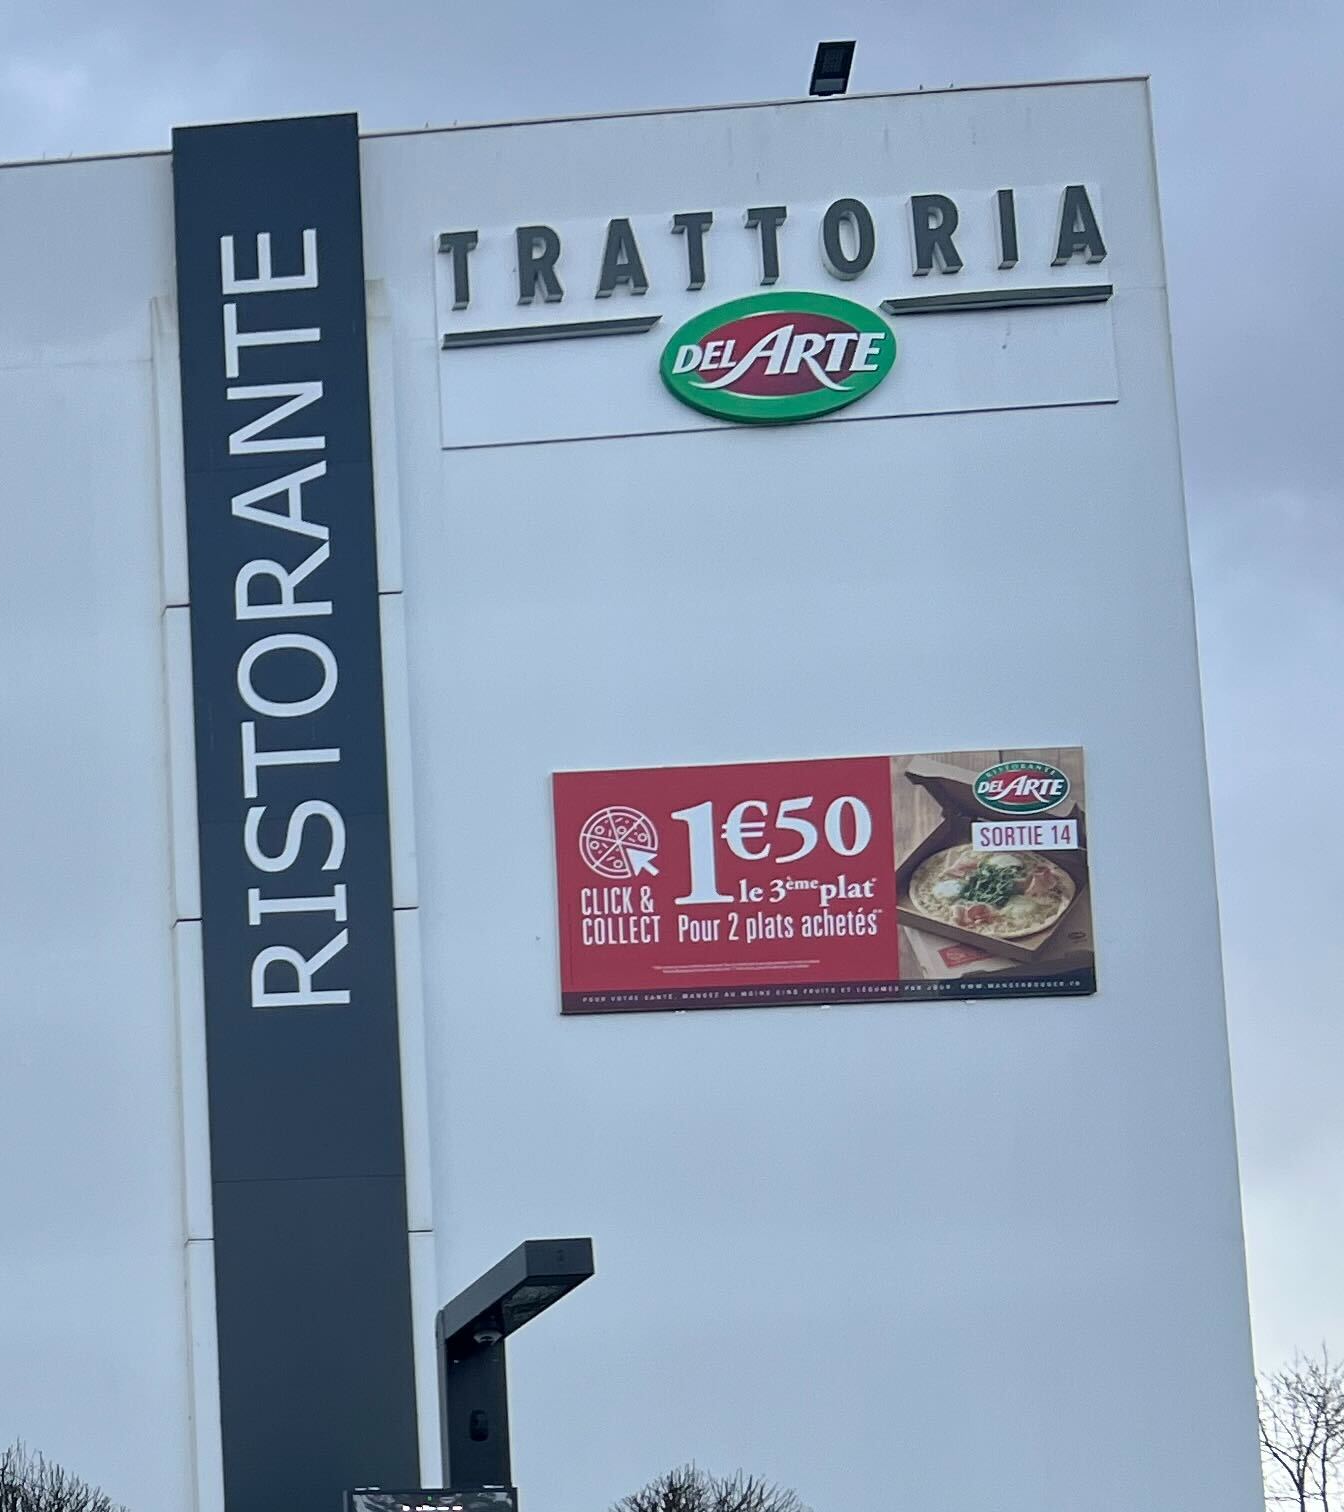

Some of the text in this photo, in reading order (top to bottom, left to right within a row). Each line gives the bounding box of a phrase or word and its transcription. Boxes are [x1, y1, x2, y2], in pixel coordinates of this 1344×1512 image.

[438, 185, 1108, 311] TRATTORIA
[220, 227, 351, 1008] RISTORANTE
[980, 825, 1071, 847] SORTIE 14
[581, 886, 654, 915] CLICK &
[739, 879, 763, 903] le
[769, 876, 819, 903] 3ème
[582, 916, 661, 945] COLLECT
[678, 914, 720, 942] Pour
[728, 912, 739, 941] 2
[745, 912, 794, 944] plats
